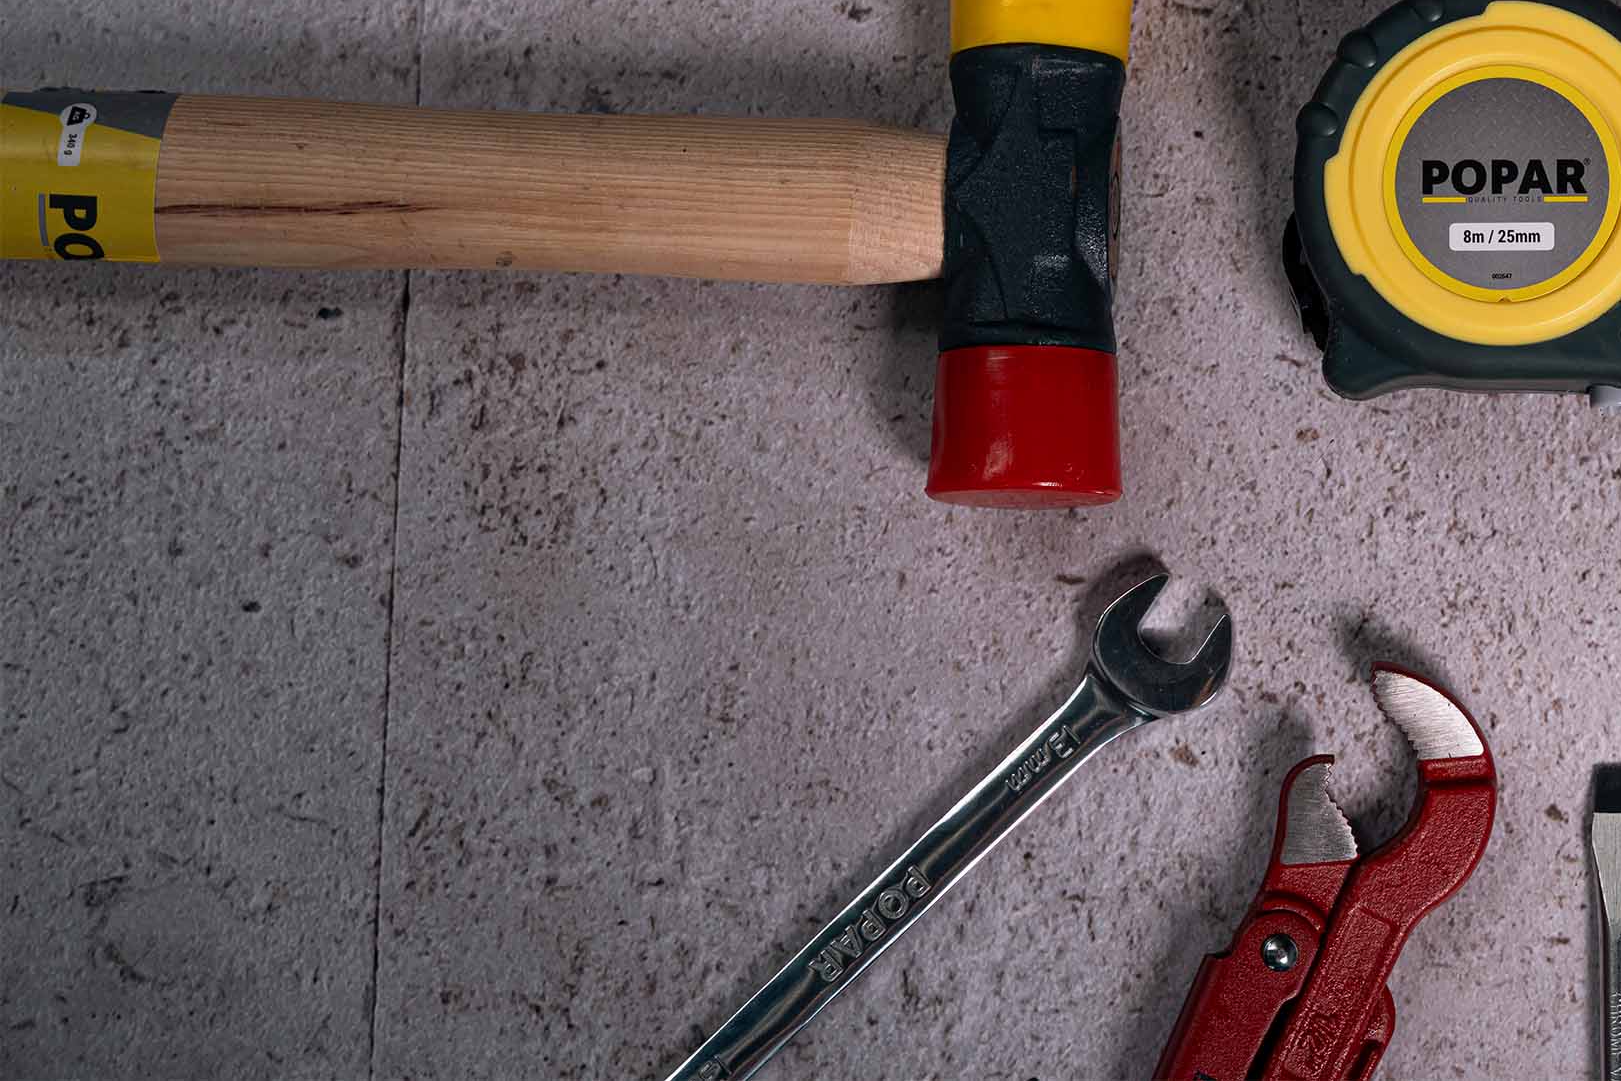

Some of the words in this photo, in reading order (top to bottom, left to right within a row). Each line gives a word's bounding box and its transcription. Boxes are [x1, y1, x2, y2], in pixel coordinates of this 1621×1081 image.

[67, 134, 77, 149] 340
[1464, 230, 1484, 243] 8m
[1488, 230, 1494, 244] /
[1498, 230, 1541, 243] 25mm
[808, 865, 933, 983] POPAR
